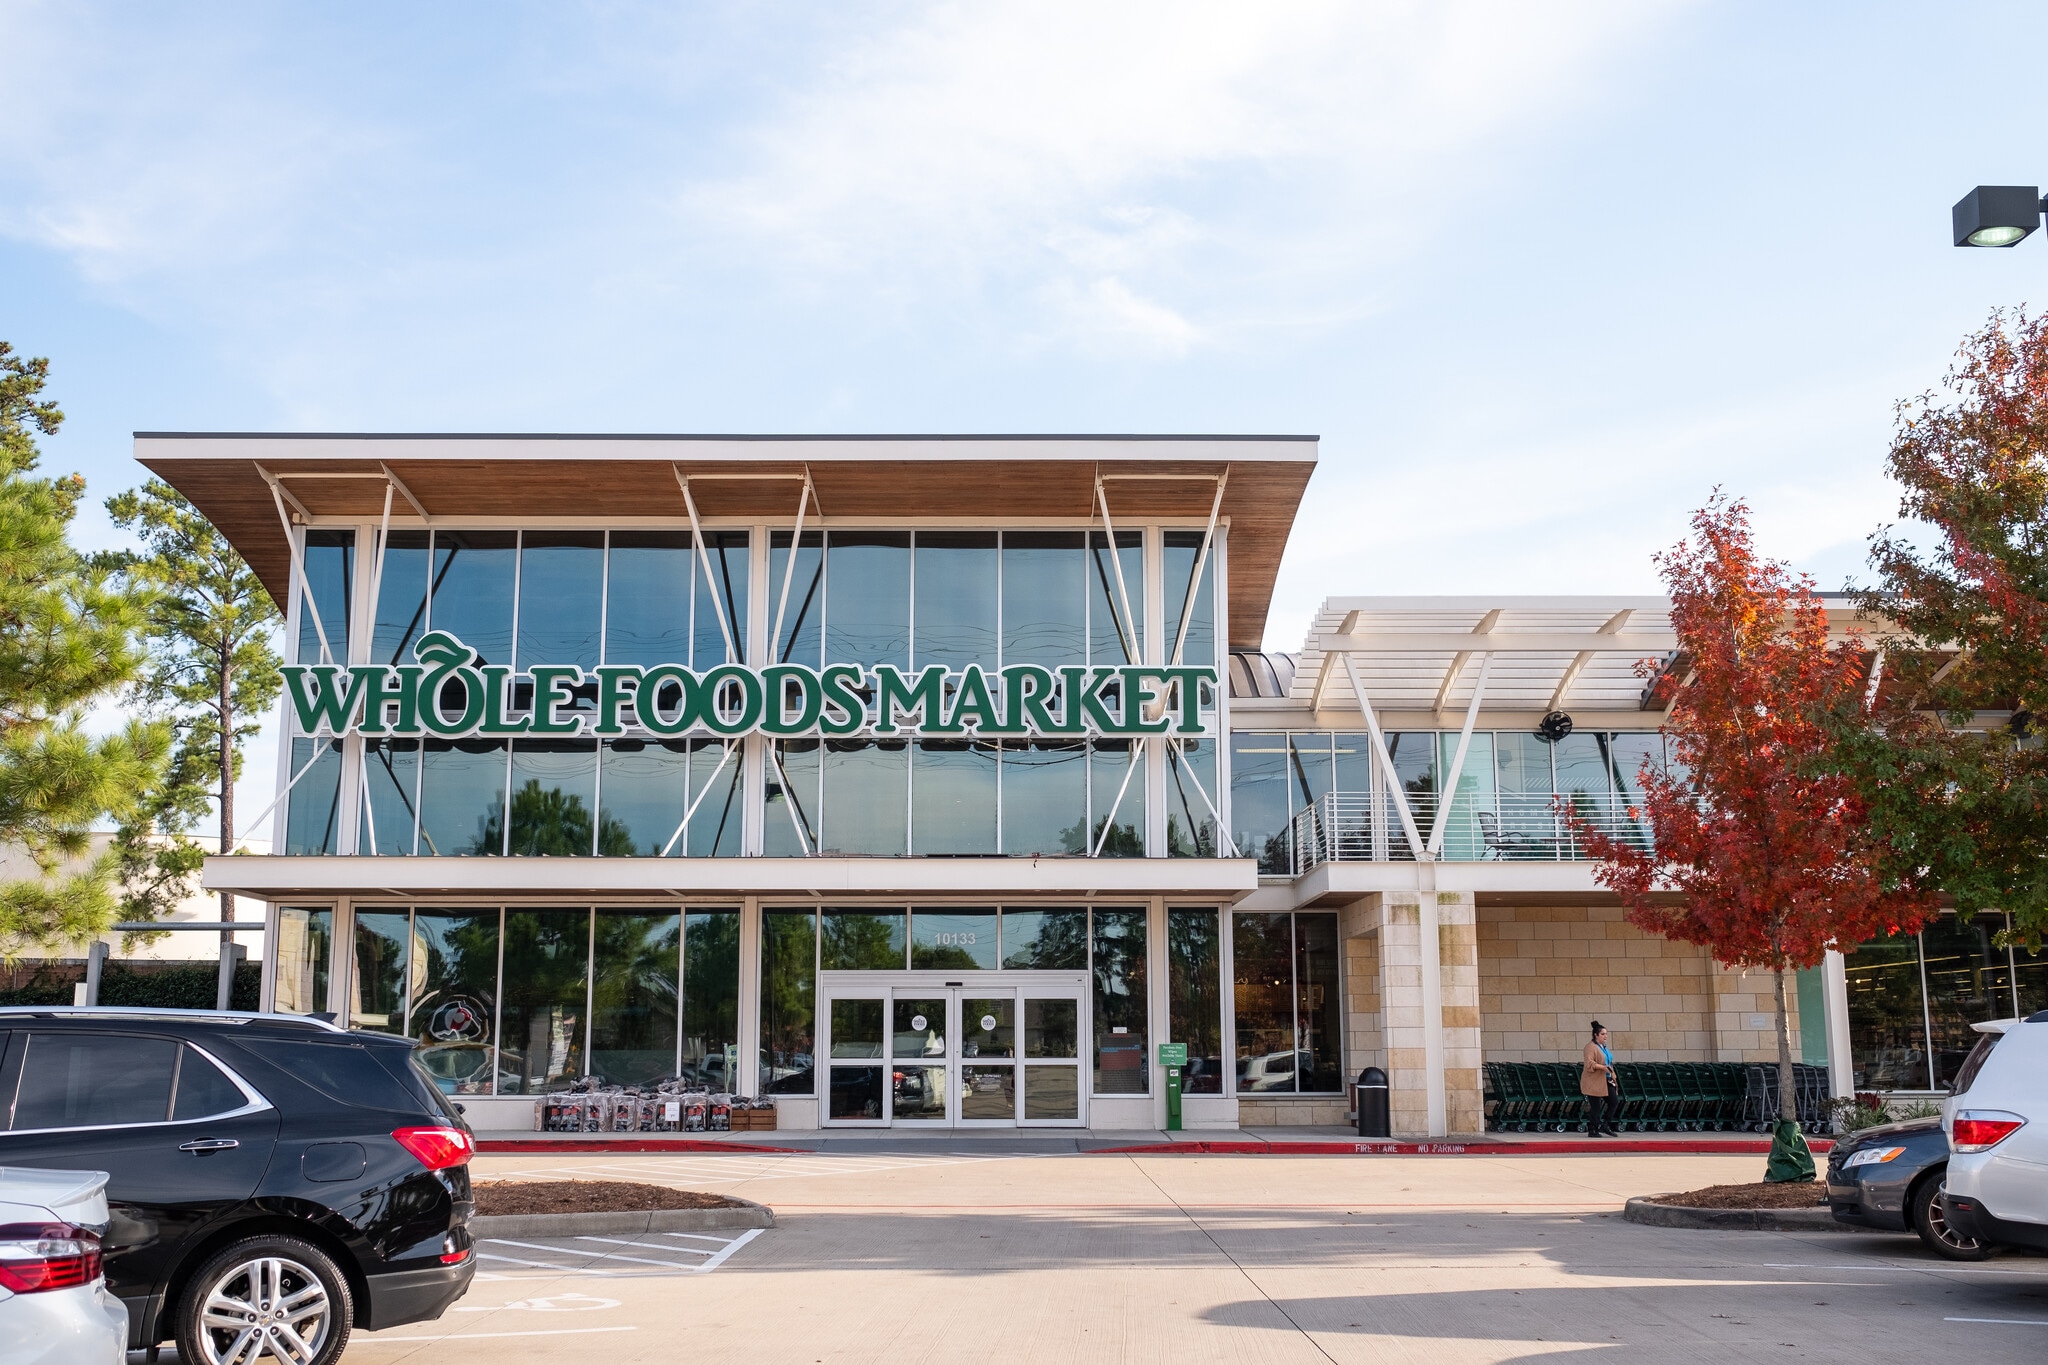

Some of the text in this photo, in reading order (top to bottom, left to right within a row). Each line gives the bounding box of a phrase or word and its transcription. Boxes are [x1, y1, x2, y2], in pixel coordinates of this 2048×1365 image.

[279, 632, 1221, 739] WHOLE FOODS MARKET
[934, 932, 976, 945] 10133
[1355, 1144, 1373, 1153] FIRE
[1418, 1144, 1429, 1153] NO
[1431, 1144, 1465, 1153] PARKING
